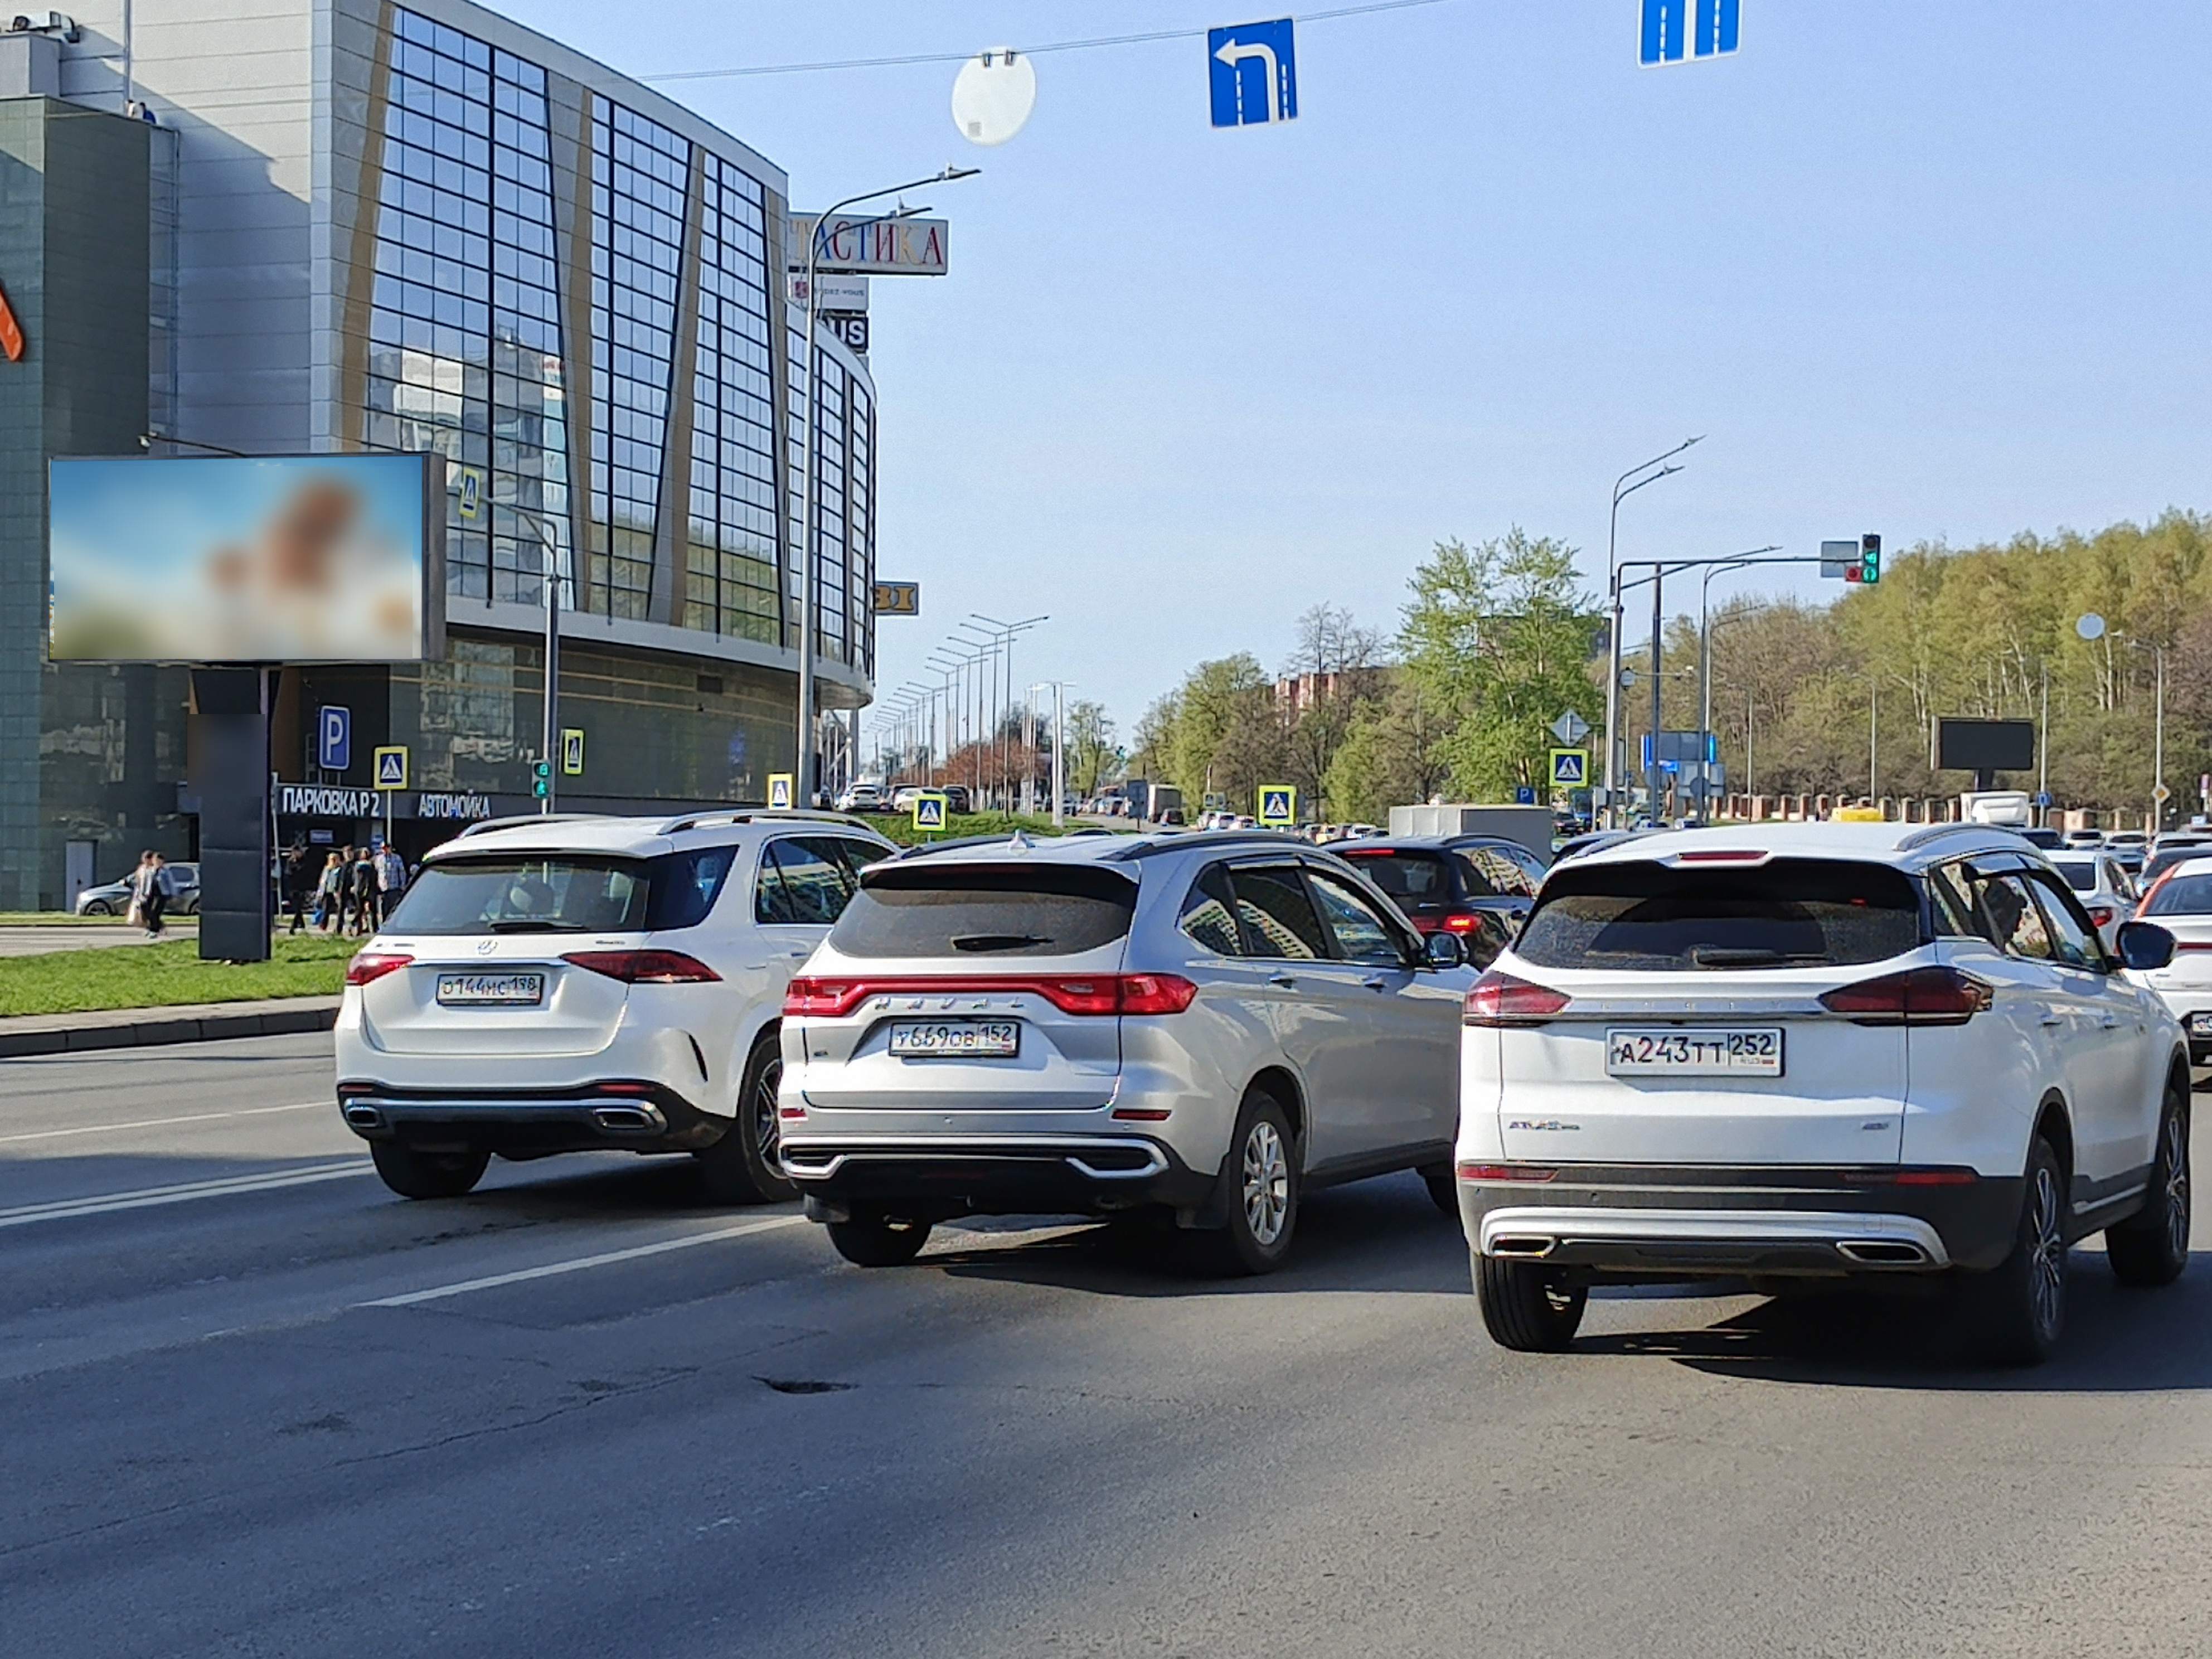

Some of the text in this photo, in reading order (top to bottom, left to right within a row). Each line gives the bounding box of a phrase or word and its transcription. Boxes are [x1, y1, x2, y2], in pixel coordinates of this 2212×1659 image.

[327, 714, 343, 761] P
[283, 788, 358, 816] ПАРКОВКА
[419, 789, 490, 818] АВТОМОЙКА
[1731, 1034, 1776, 1055] 252
